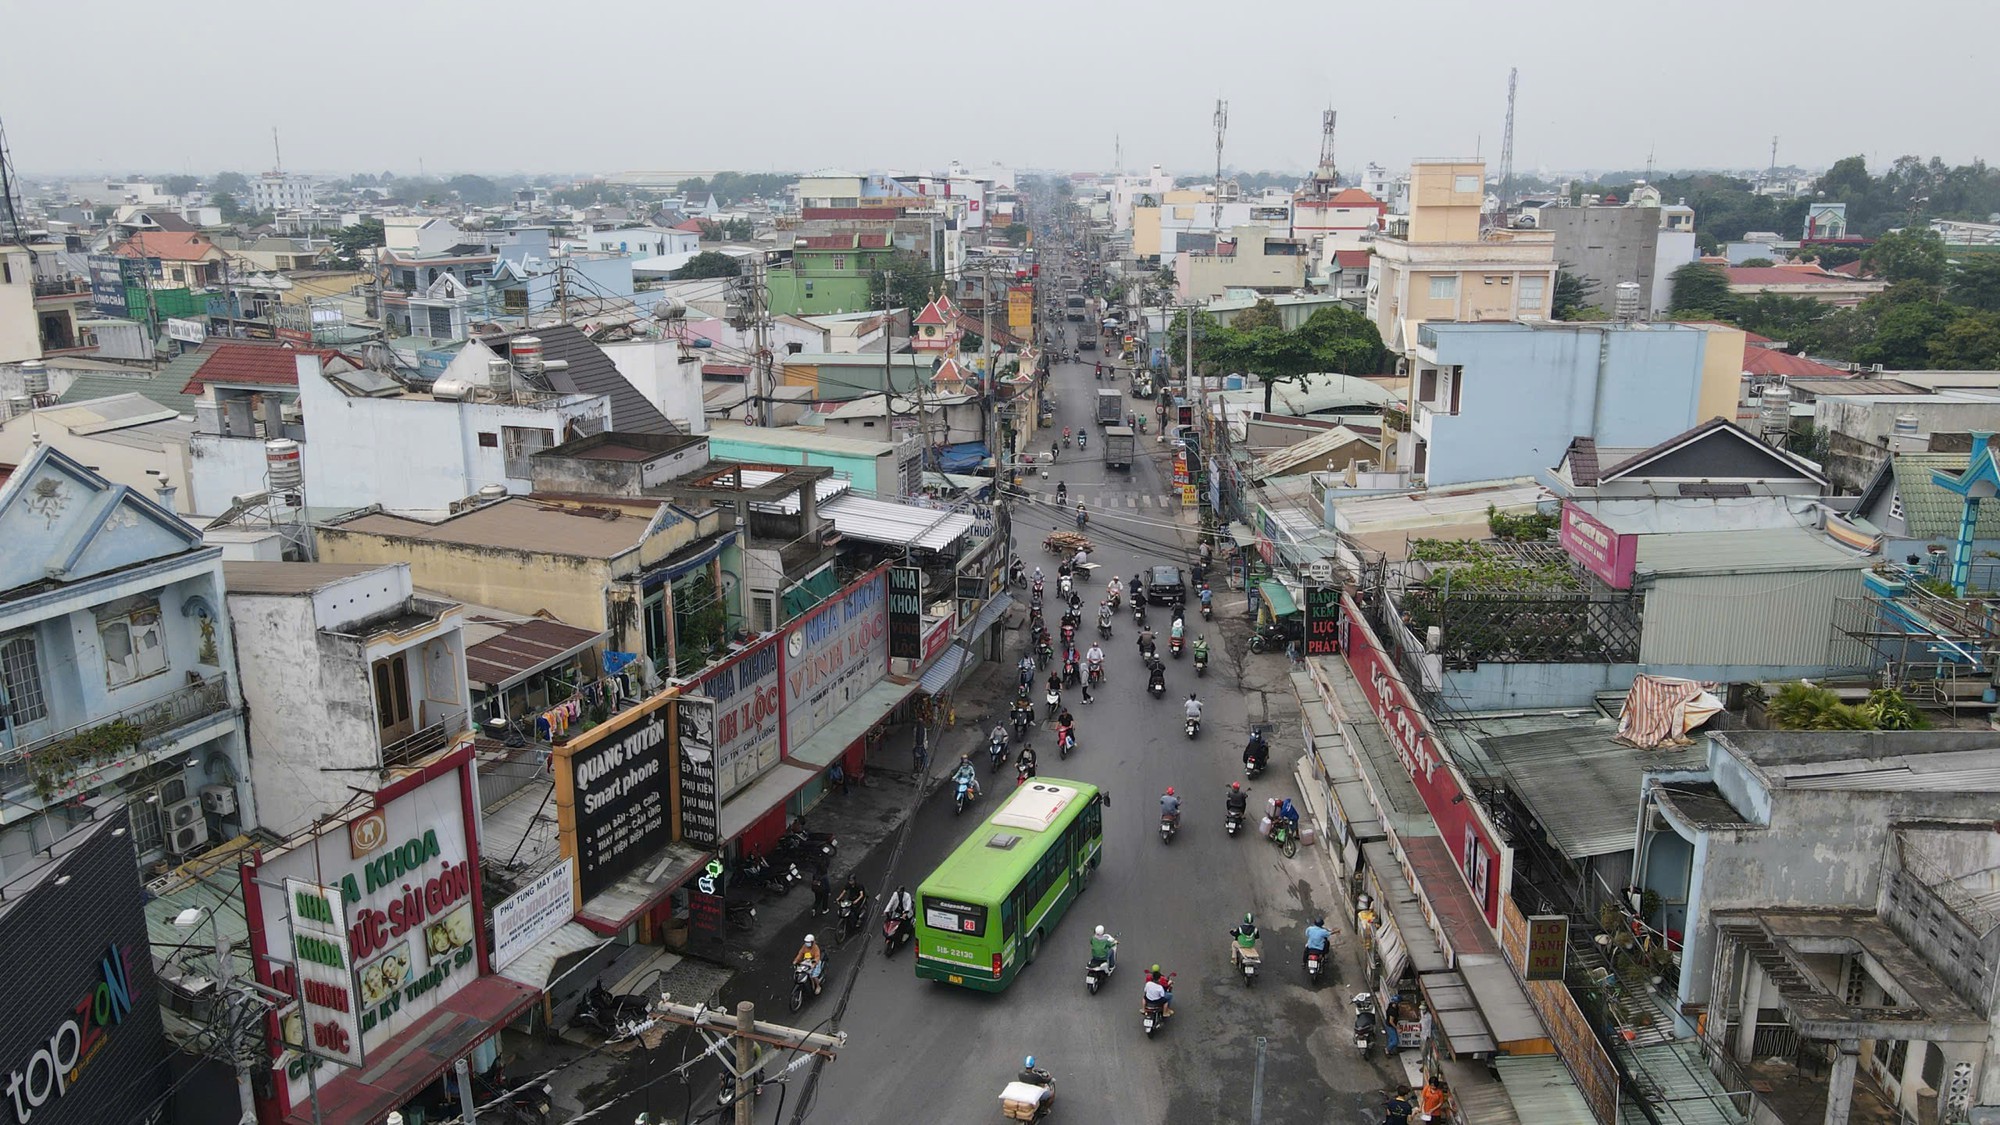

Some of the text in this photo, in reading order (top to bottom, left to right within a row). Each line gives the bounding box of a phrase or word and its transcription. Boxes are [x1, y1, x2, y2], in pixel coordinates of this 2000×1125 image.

[892, 570, 916, 590] NHA
[806, 577, 884, 649] NHA KHOA
[890, 594, 919, 614] KHOA
[1313, 606, 1334, 618] KEM
[1308, 638, 1337, 652] PHÁT
[1313, 620, 1334, 636] LỰC
[705, 644, 777, 704] NHA KHOA
[789, 636, 844, 699] VĨNH
[848, 611, 884, 659] LỘC
[742, 684, 778, 734] LỘC
[1378, 704, 1416, 779] BAKERY
[576, 743, 624, 791] QUANG
[584, 758, 659, 814] Smart phone
[684, 829, 714, 842] LAPTOP
[364, 829, 440, 894] KHOA
[295, 892, 334, 924] NHA
[388, 884, 426, 938] SÀI
[425, 860, 470, 916] GÒN
[296, 934, 345, 970] KHOA
[1536, 954, 1558, 967] MÌ
[405, 959, 452, 1003] THUẬT
[314, 1020, 350, 1054] ĐỨC
